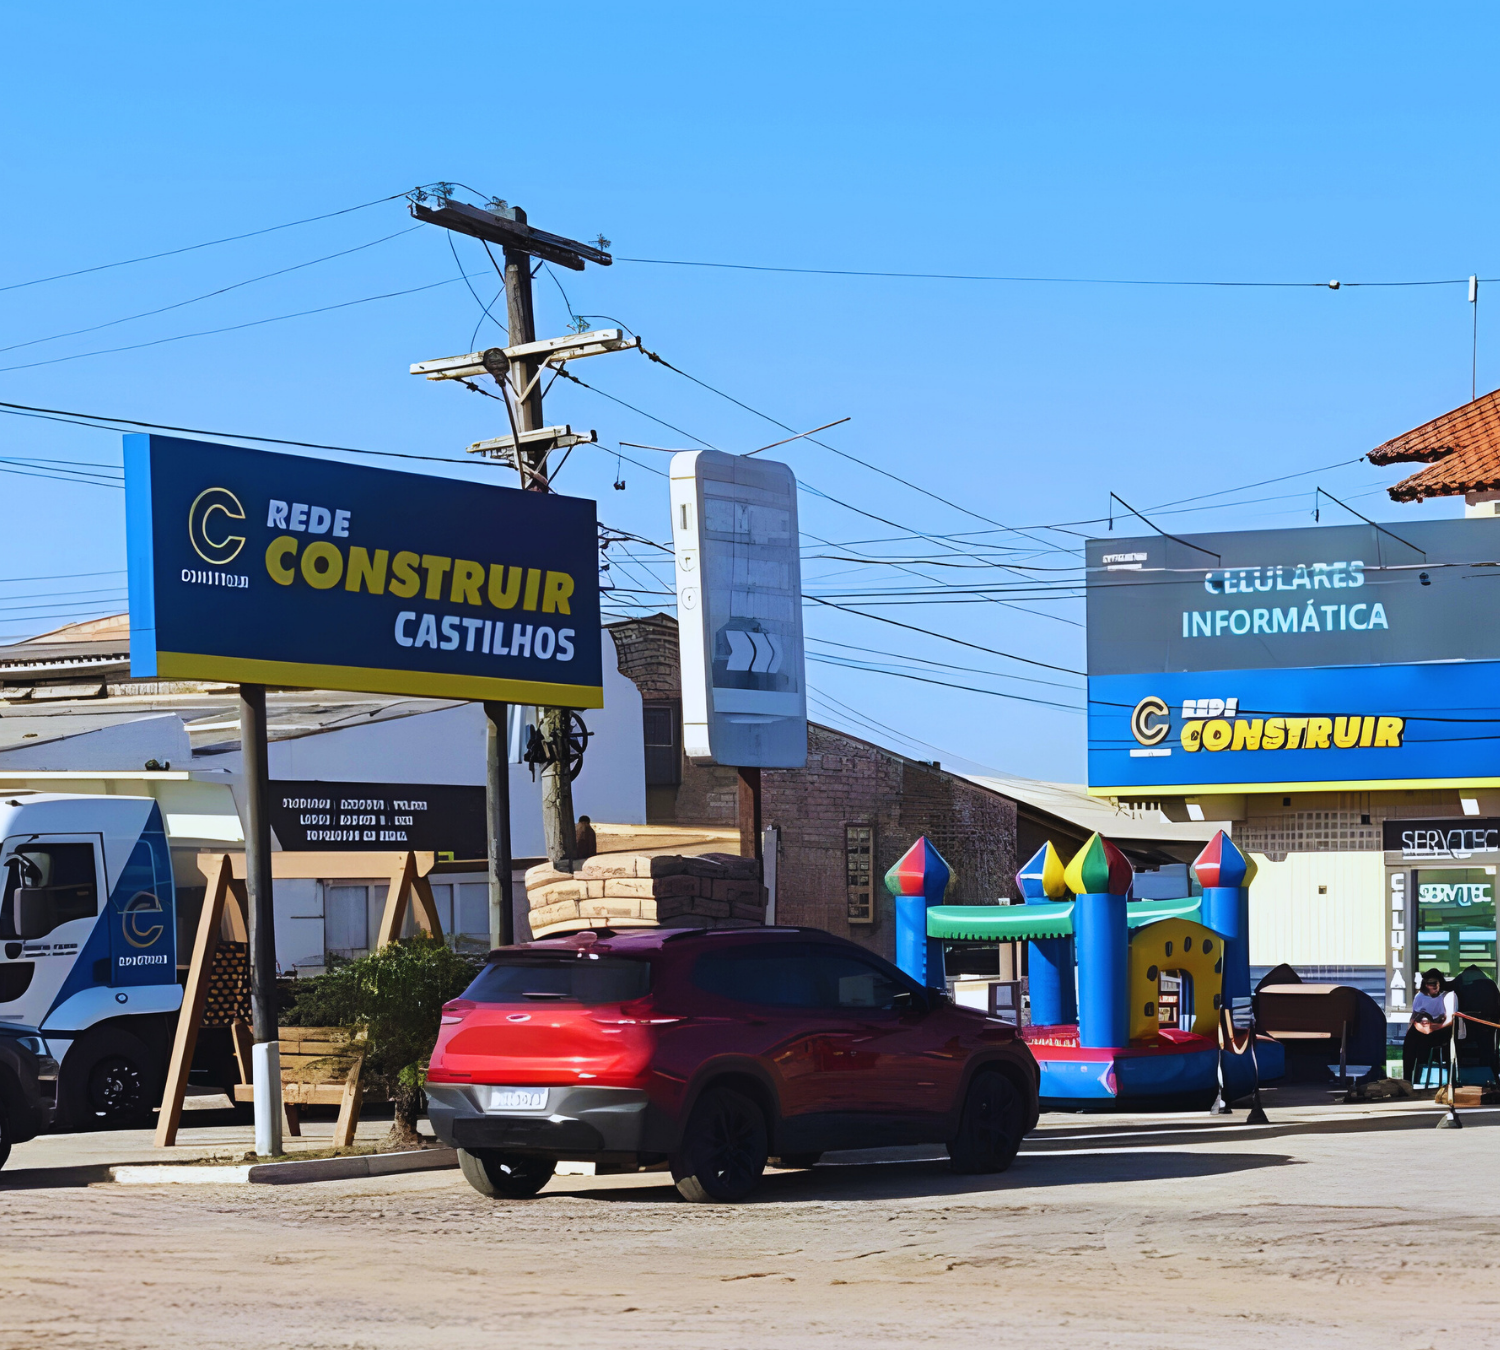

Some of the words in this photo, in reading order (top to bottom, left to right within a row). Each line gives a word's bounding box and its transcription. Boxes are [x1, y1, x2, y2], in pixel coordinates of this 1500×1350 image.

[267, 499, 351, 537] REDE
[265, 535, 575, 615] CONSTRUIR
[1205, 560, 1365, 595] CELULARES
[394, 611, 576, 661] CASTILHOS
[1182, 599, 1389, 638] INFORMÁTICA
[1180, 716, 1404, 753] CONSTRUIR
